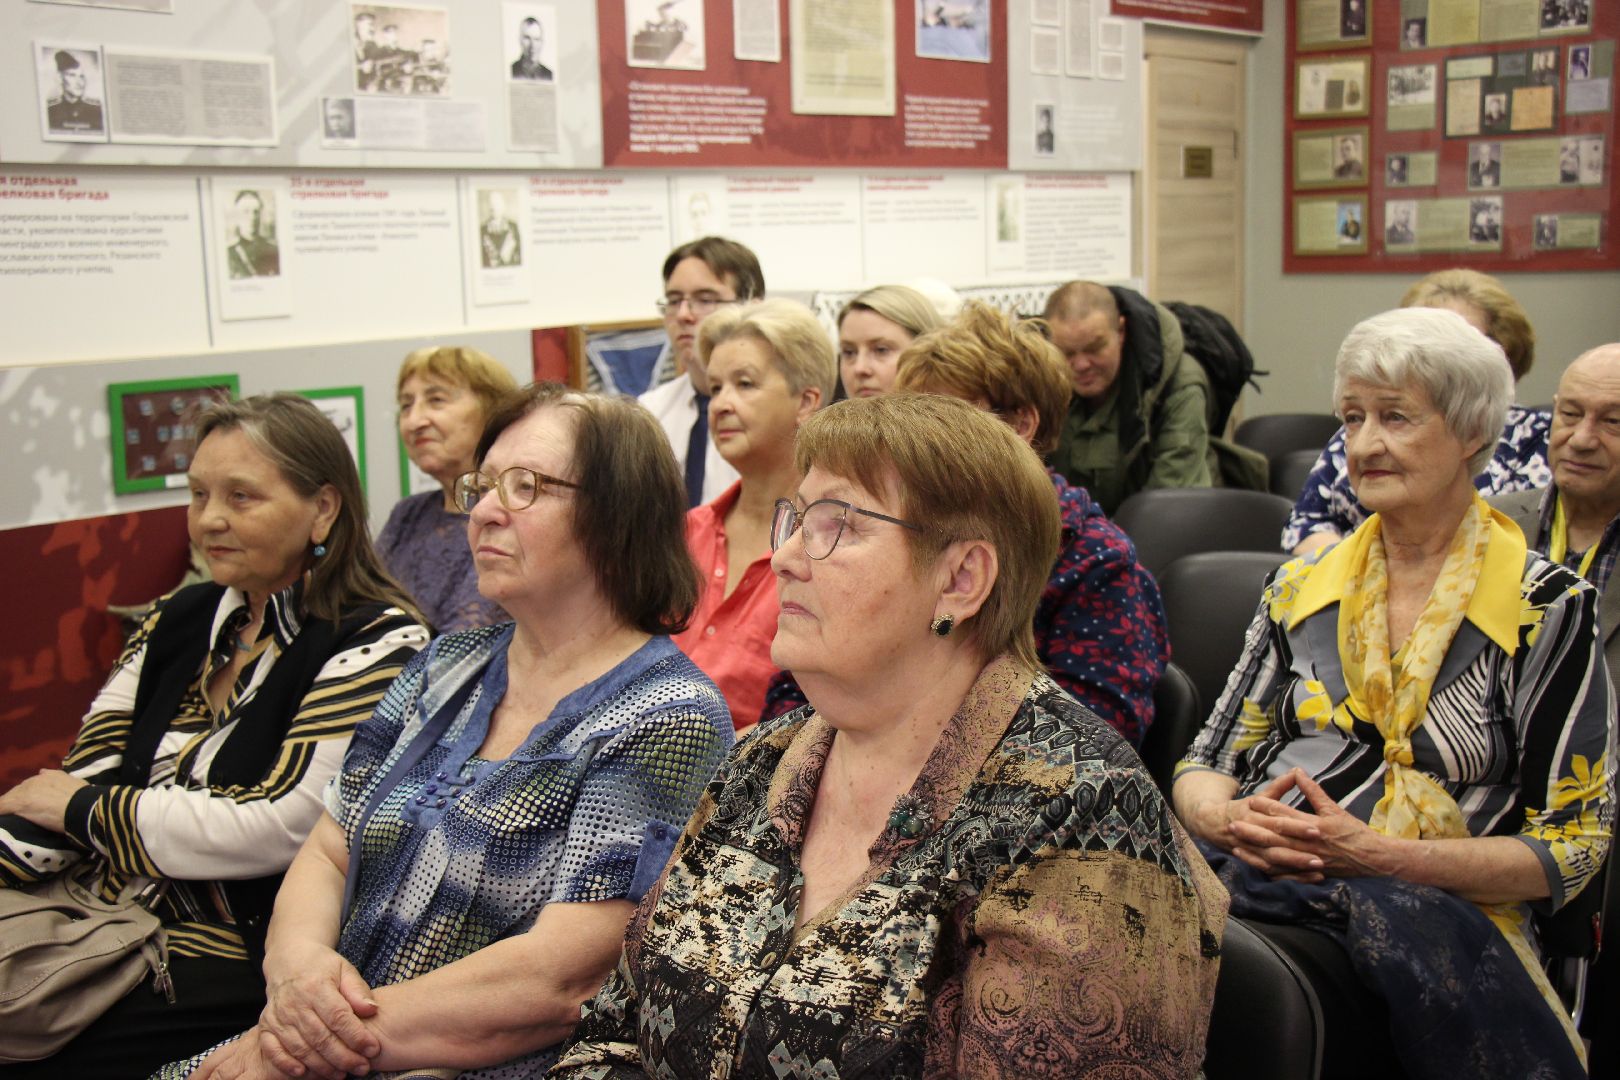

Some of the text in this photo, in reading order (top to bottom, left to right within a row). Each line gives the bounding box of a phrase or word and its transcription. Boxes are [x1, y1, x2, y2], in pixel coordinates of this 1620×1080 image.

[10, 175, 78, 187] отдельная
[0, 189, 110, 202] елковая бригада
